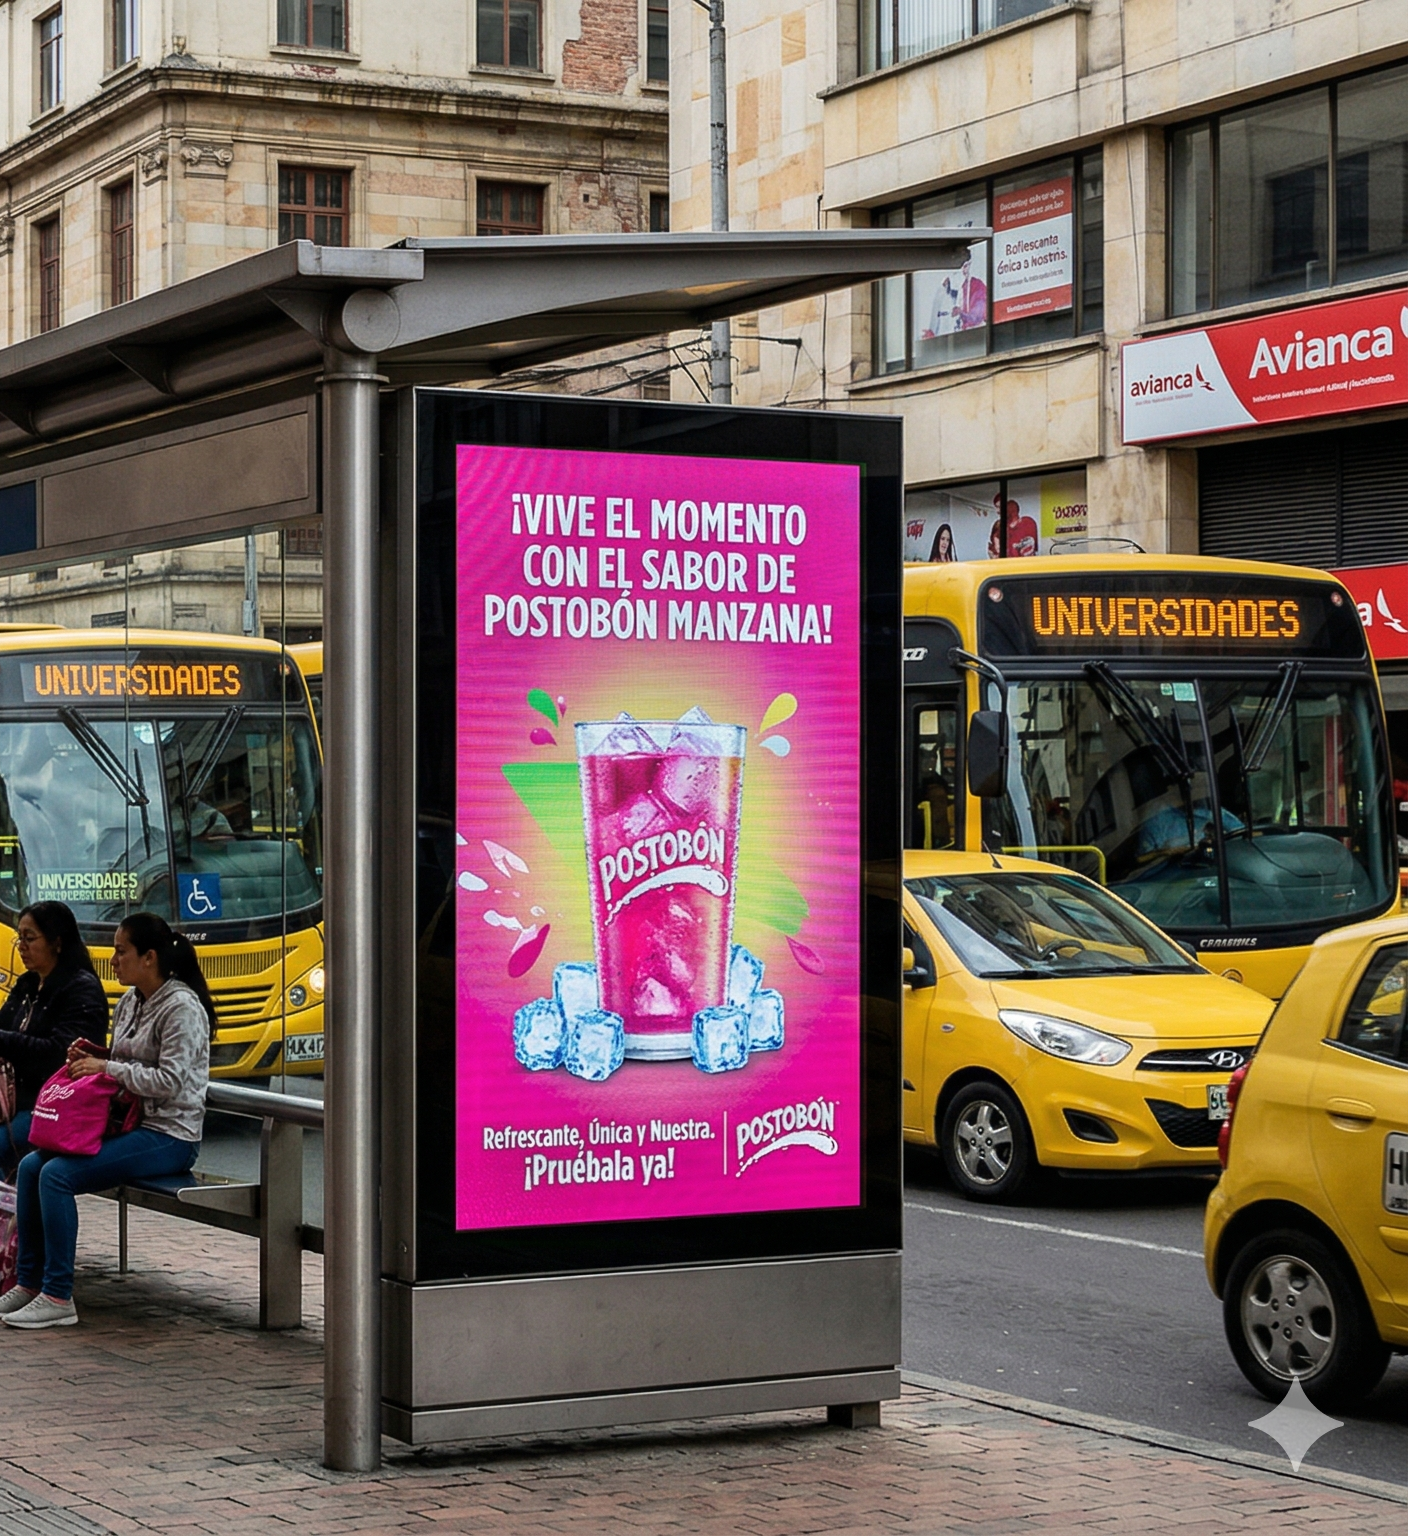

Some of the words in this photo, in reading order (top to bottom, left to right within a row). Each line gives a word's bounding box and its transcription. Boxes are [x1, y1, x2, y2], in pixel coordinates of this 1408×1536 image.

[1248, 325, 1394, 380] Avianca
[1130, 372, 1193, 397] avianca
[512, 494, 595, 537] ¡VIVE
[606, 498, 641, 539] EL
[651, 499, 807, 546] MOMENTO
[523, 545, 588, 588] CON
[598, 548, 633, 589] EL
[642, 550, 748, 593] SABOR
[758, 554, 796, 594] DE
[484, 590, 658, 640] POSTOBÓN
[668, 600, 833, 644] MANZANA!
[1032, 596, 1300, 638] UNIVERSIDADES
[34, 663, 241, 697] UNIVERSIDADES
[483, 1124, 585, 1150] Refrescante,
[589, 1117, 633, 1145] Única
[637, 1126, 647, 1147] y
[651, 1119, 716, 1143] Nuestra.
[524, 1149, 635, 1191] ¡Pruébala
[641, 1147, 675, 1186] ya!
